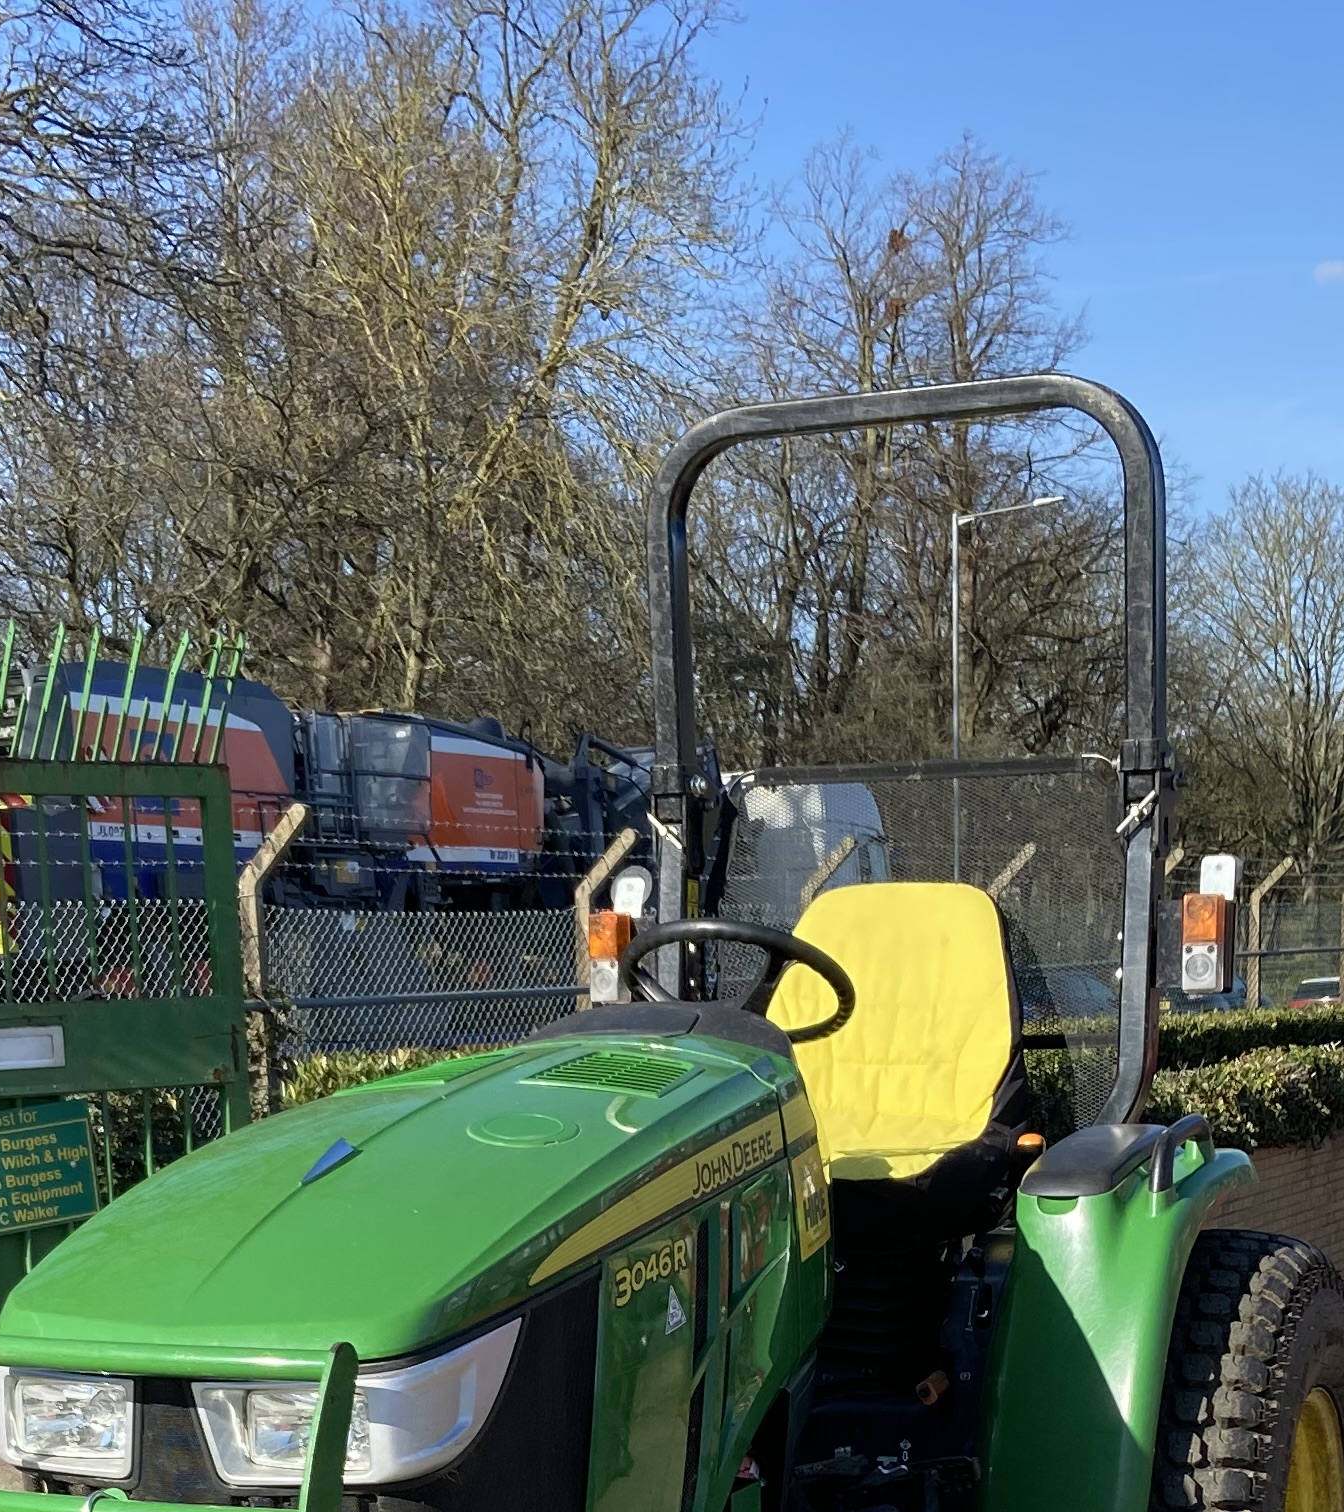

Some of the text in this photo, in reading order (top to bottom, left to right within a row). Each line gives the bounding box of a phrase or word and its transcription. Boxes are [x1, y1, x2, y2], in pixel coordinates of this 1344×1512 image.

[18, 1109, 37, 1124] for
[1, 1133, 57, 1152] Burgess
[1, 1153, 40, 1170] Wilch
[44, 1149, 54, 1163] &
[57, 1145, 88, 1162] High
[692, 1129, 774, 1196] JOHN DEERE
[6, 1168, 62, 1188] Burgess
[11, 1181, 84, 1207] Equipment
[0, 1212, 9, 1225] C
[13, 1205, 60, 1222] Walker
[803, 1187, 826, 1232] HIRE
[614, 1239, 687, 1308] 3046R
